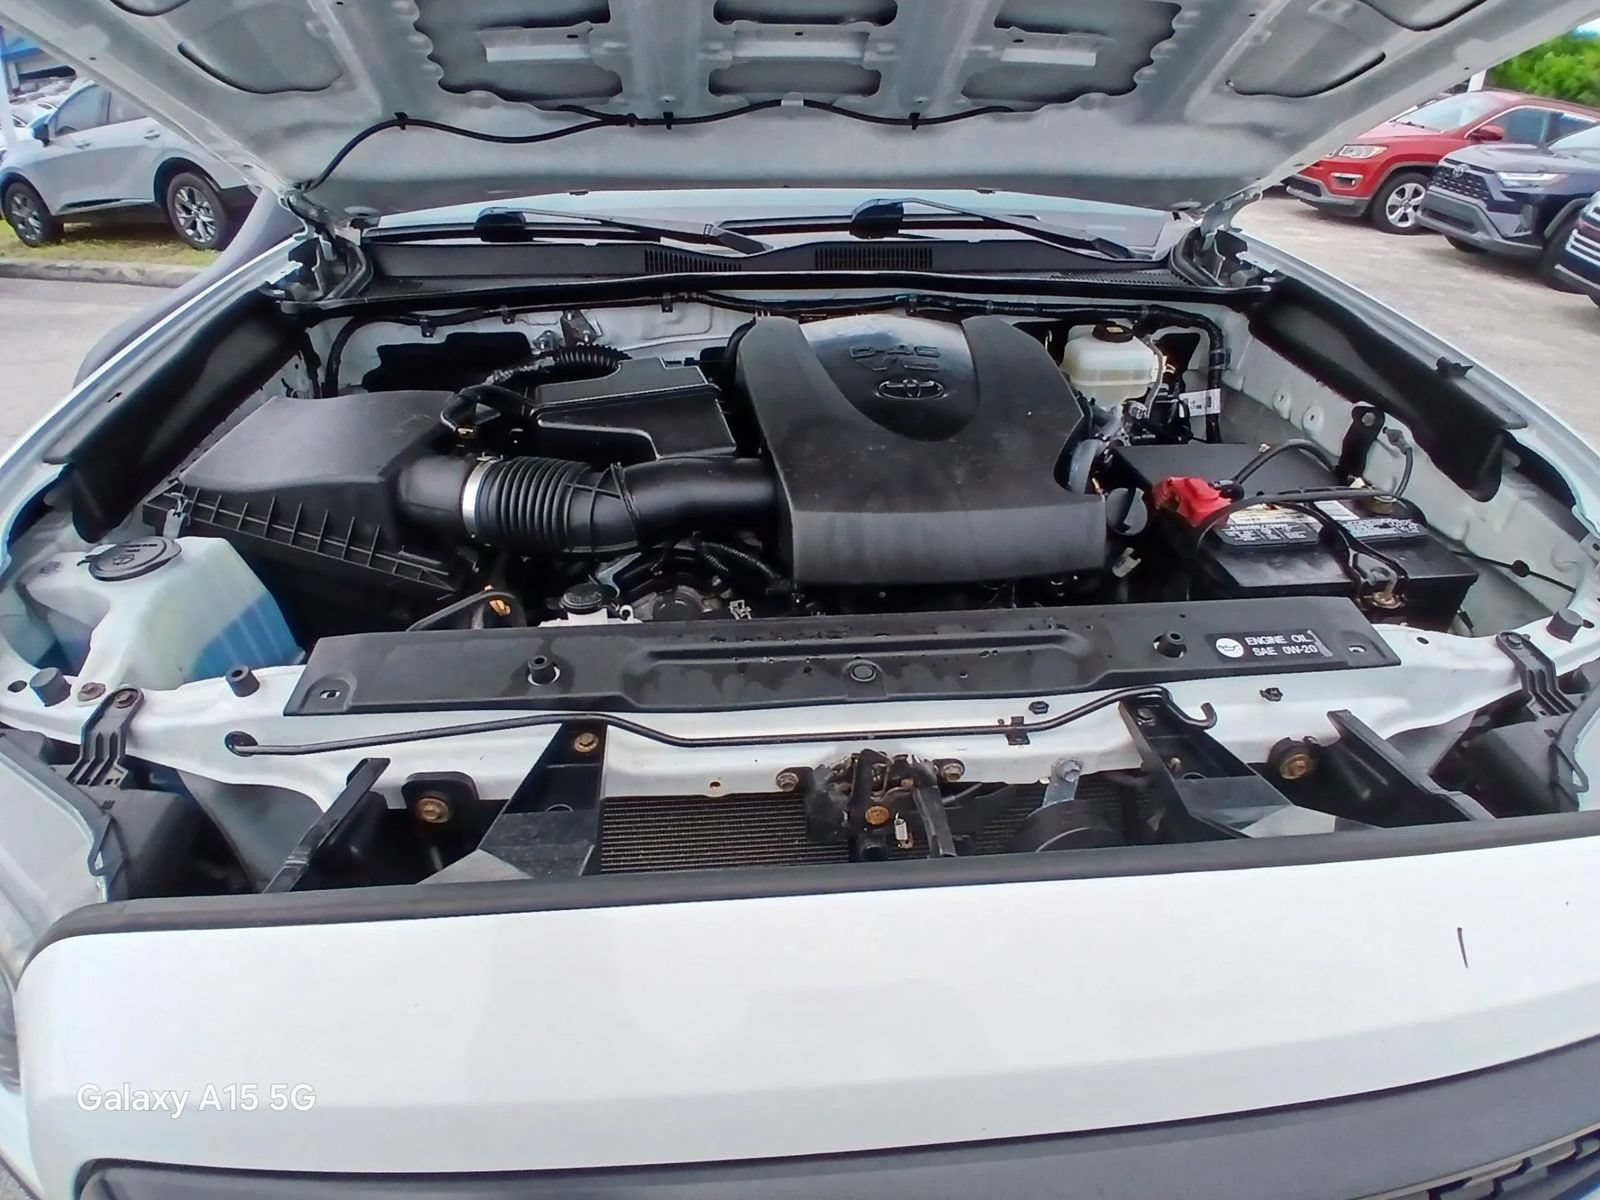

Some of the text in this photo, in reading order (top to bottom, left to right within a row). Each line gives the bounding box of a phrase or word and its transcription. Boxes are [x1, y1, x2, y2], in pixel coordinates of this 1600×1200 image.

[1244, 634, 1315, 646] ENGINE OIL
[1252, 644, 1318, 656] SAE 0W-20
